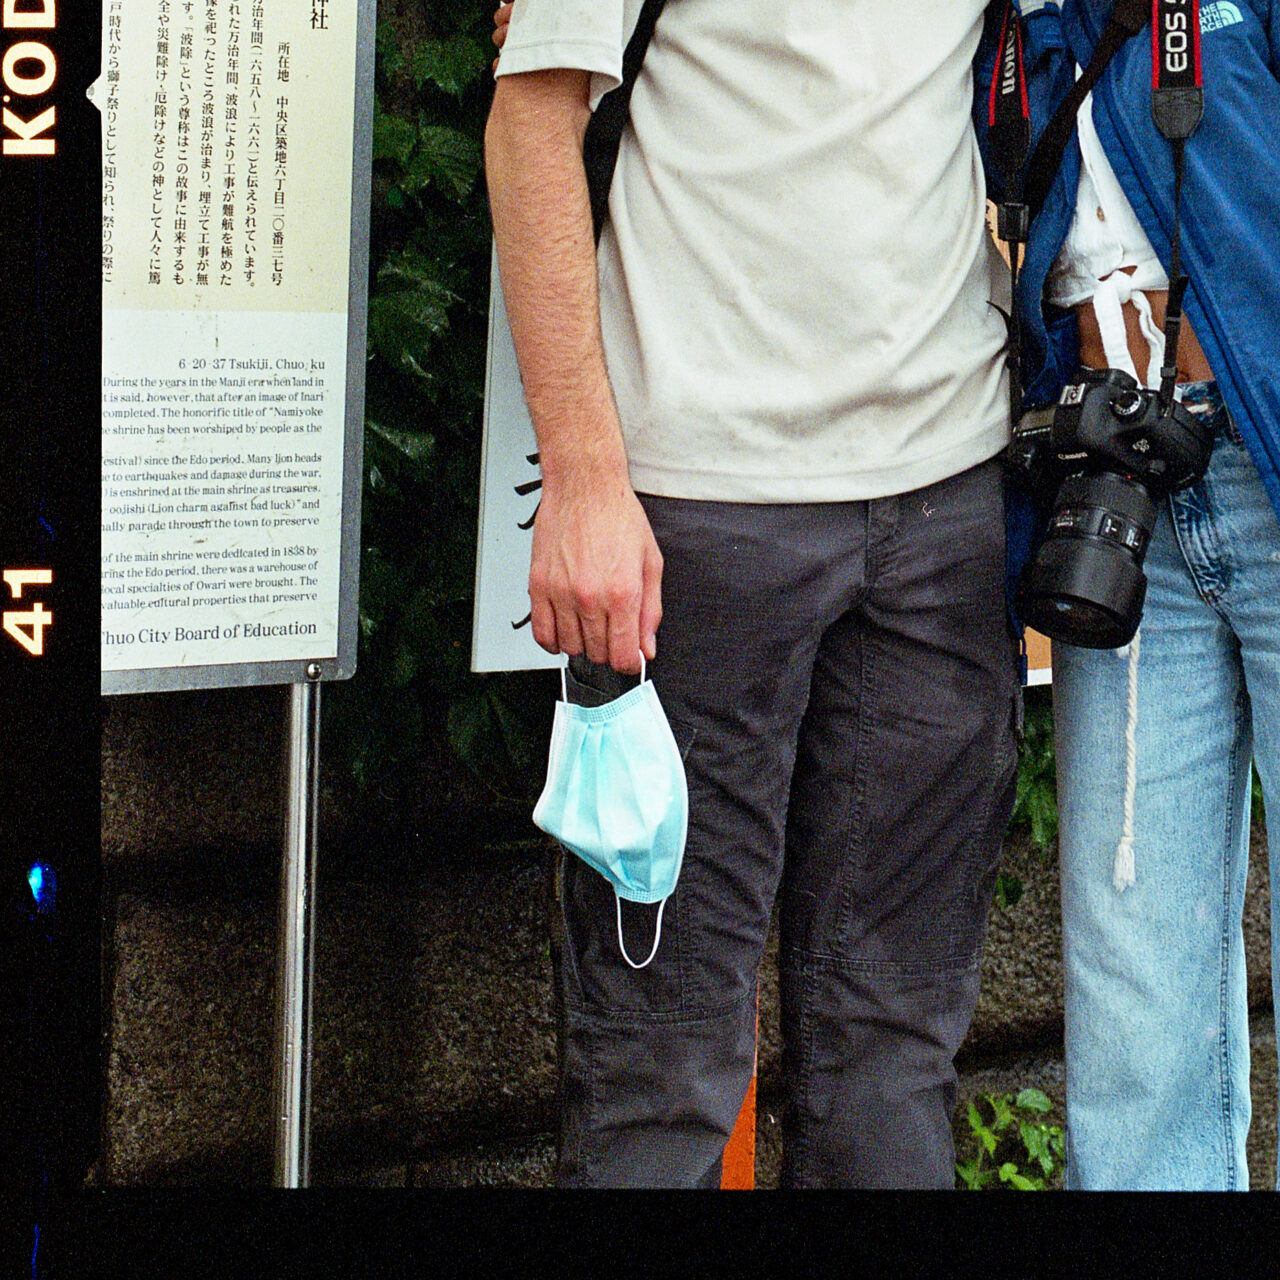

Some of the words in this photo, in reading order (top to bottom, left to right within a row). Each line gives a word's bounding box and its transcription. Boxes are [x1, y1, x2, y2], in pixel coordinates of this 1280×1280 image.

[1200, 22, 1223, 35] ACE
[1165, 12, 1188, 72] EOS
[277, 41, 290, 82] 所在地
[228, 358, 273, 370] Tsukiji,
[140, 377, 157, 387] the
[159, 379, 187, 388] years
[189, 377, 198, 387] in
[201, 377, 217, 387] the
[219, 377, 246, 387] Manji
[266, 376, 291, 387] when
[292, 376, 313, 387] land
[315, 377, 324, 387] in
[161, 408, 181, 418] The
[182, 407, 231, 417] honorific
[233, 407, 254, 417] title
[255, 407, 267, 417] of
[293, 425, 305, 433] as
[306, 423, 322, 433] the
[144, 455, 170, 465] since
[171, 455, 188, 465] the
[190, 454, 208, 465] Edo
[209, 453, 245, 465] period.
[247, 453, 272, 464] Many
[294, 452, 322, 463] heads
[176, 502, 208, 513] charm
[210, 501, 248, 512] against
[250, 500, 268, 510] bad
[302, 499, 320, 509] and
[115, 552, 133, 563] the
[134, 551, 159, 562] main
[161, 550, 194, 561] shrine
[221, 548, 269, 559] dedicated
[271, 547, 281, 557] in
[283, 544, 305, 556] 1838
[306, 545, 319, 556] by
[146, 596, 190, 608] cultural
[192, 594, 247, 607] properties
[249, 593, 269, 604] that
[272, 593, 318, 603] preserve
[3, 569, 52, 655] 41
[103, 632, 135, 645] huo
[138, 628, 169, 644] City
[175, 625, 220, 642] Board
[223, 624, 241, 639] of
[243, 621, 317, 638] Education
